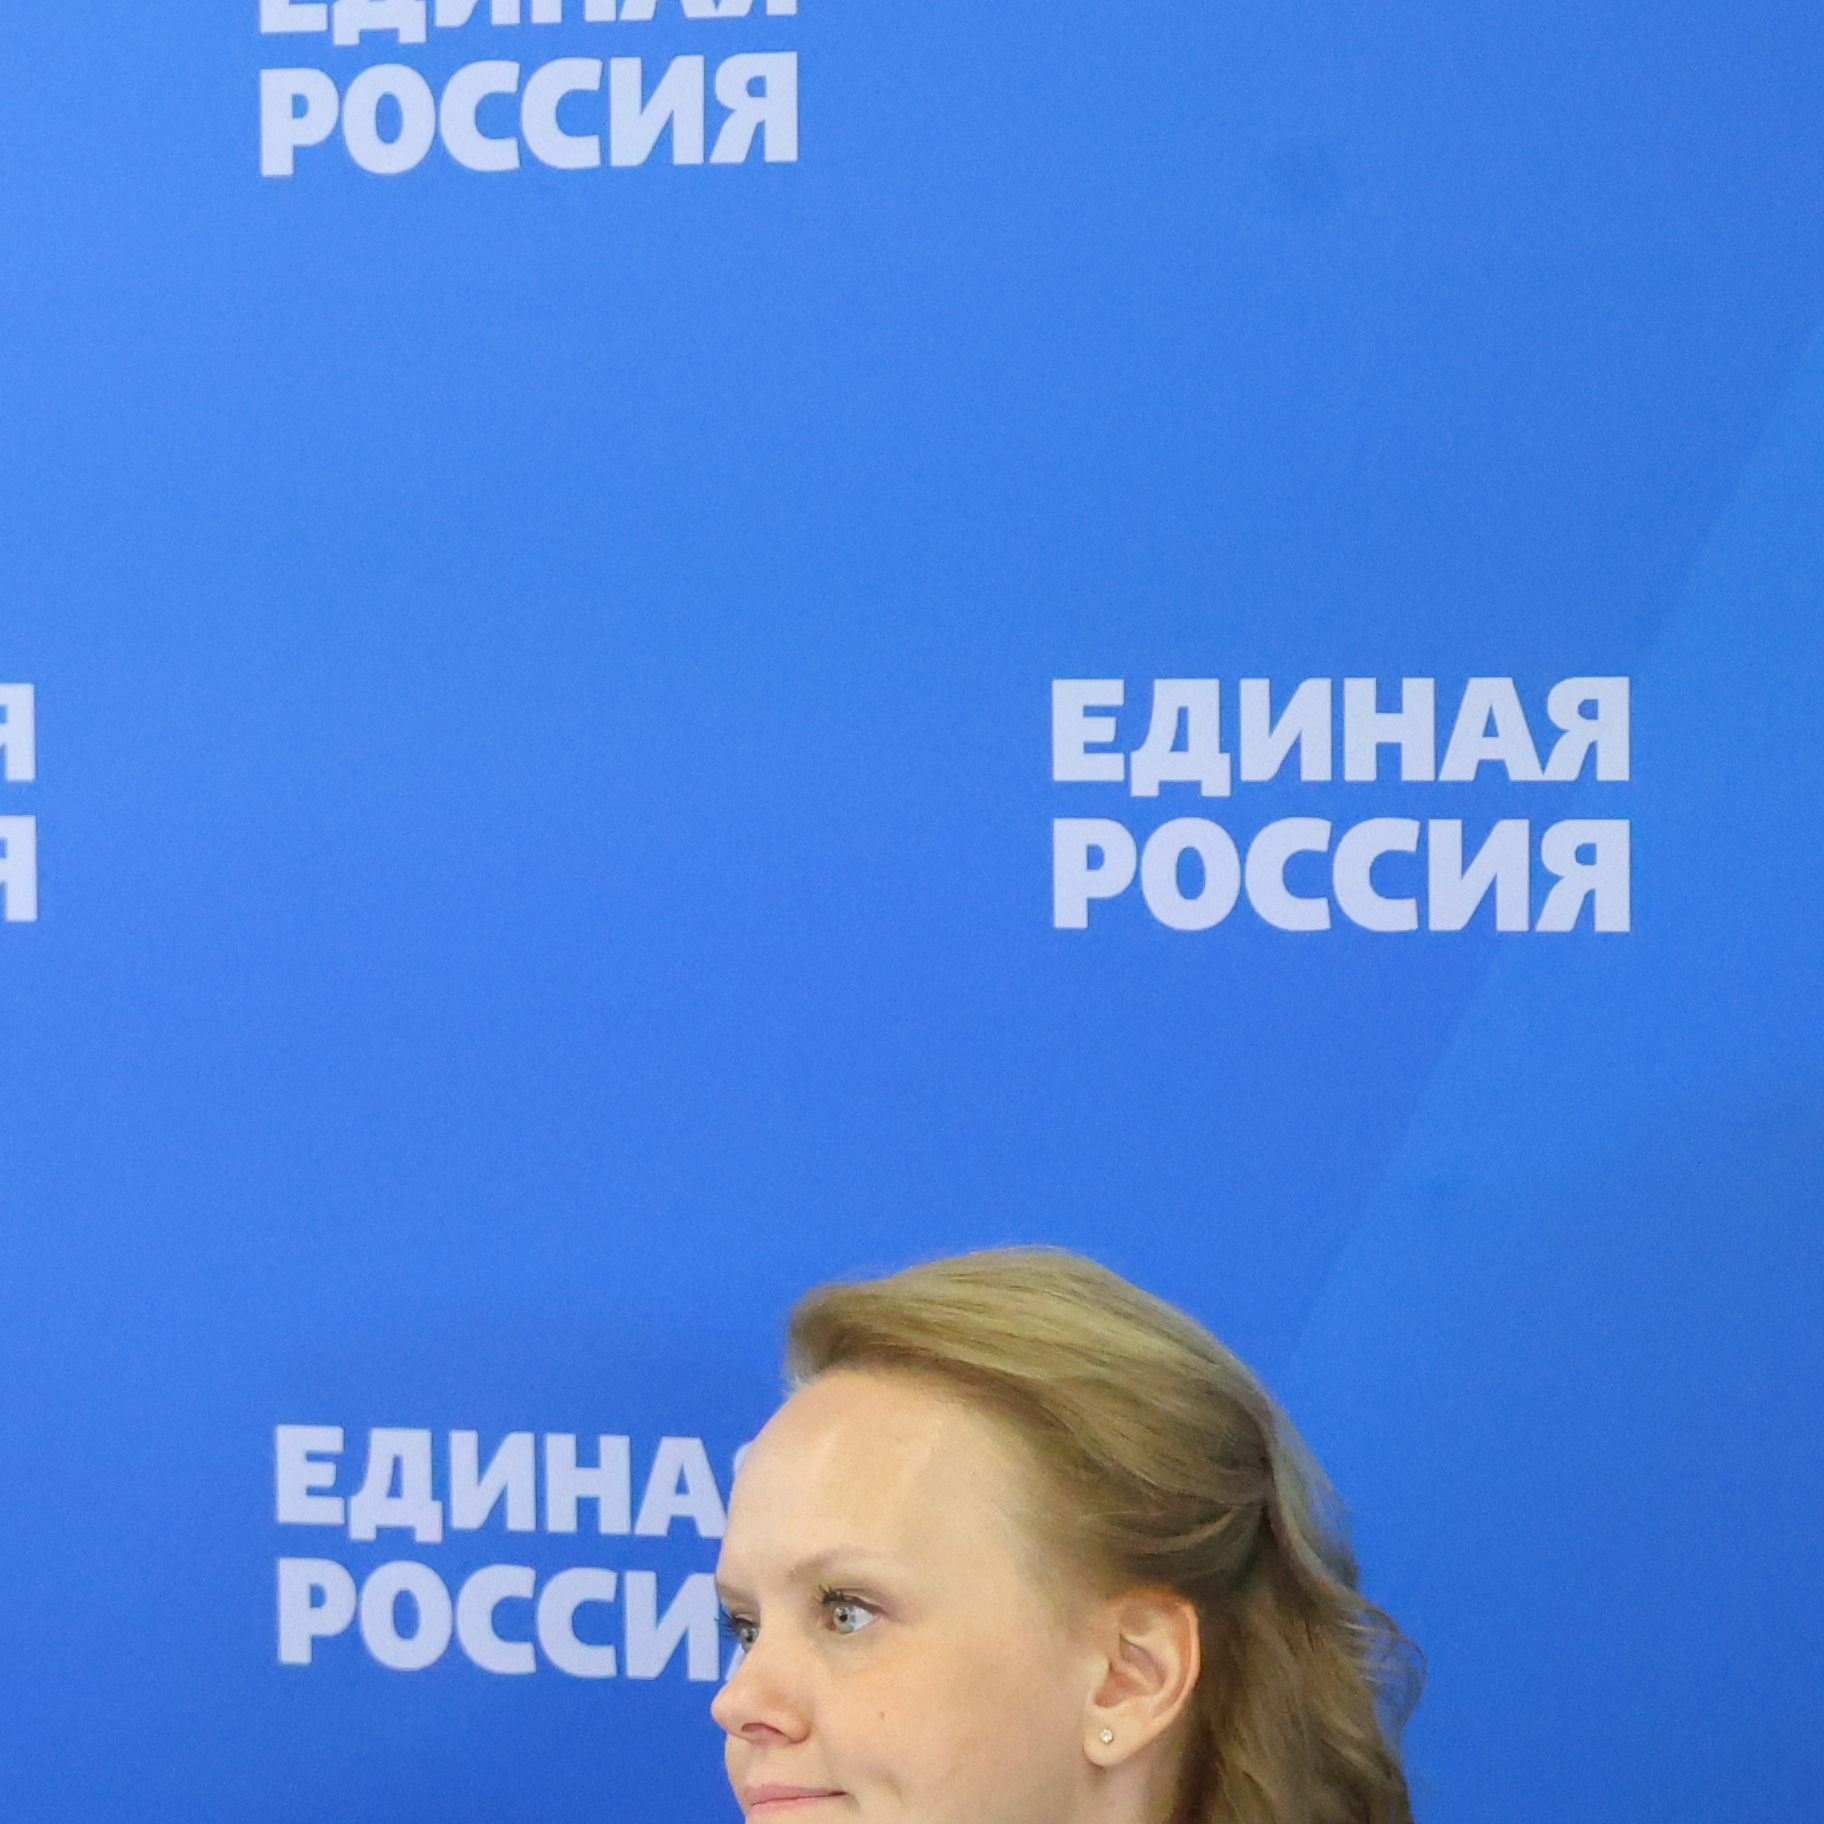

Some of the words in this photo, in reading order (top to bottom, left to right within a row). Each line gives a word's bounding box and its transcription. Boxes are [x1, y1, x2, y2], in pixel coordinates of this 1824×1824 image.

[258, 51, 800, 178] РОССИЯ
[1050, 676, 1631, 799] ЕДИНАЯ
[1052, 817, 1632, 933] РОССИЯ
[274, 1423, 750, 1543] ЕДИНА
[276, 1556, 742, 1690] РОССИ
